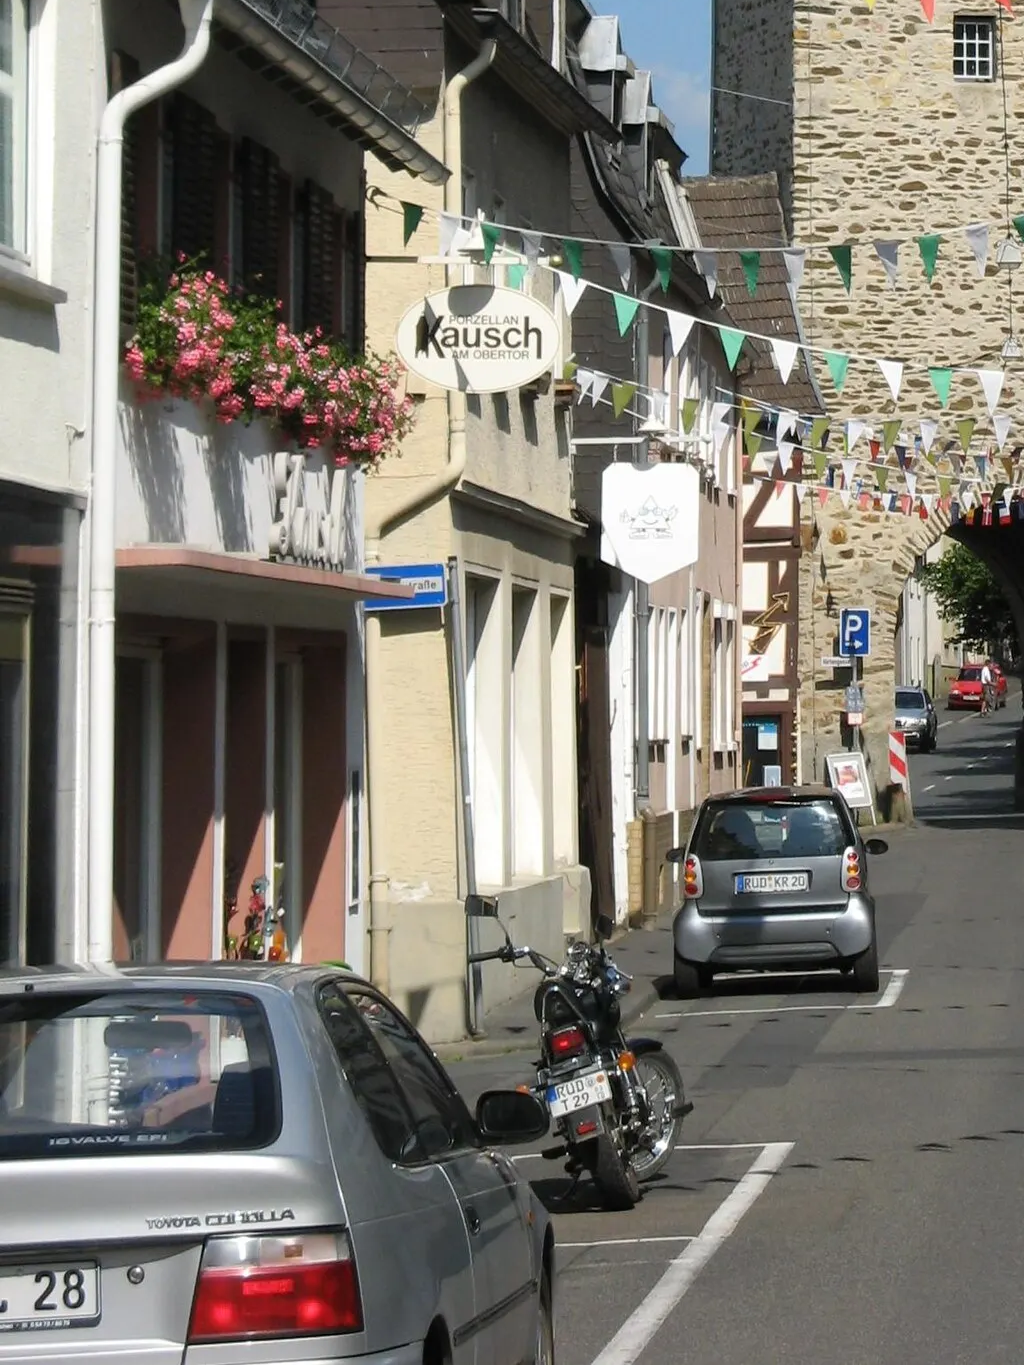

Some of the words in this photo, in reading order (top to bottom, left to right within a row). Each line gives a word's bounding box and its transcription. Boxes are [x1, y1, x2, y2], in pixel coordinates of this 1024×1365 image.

[449, 314, 519, 325] PORZELLAN
[415, 315, 542, 359] Kausch
[451, 349, 469, 359] AM
[473, 349, 530, 360] OBERTOR
[744, 877, 767, 890] RUD
[774, 876, 789, 888] KR
[791, 875, 805, 887] 20
[556, 1079, 585, 1099] RUD
[561, 1098, 569, 1111] T
[572, 1092, 590, 1109] 29
[145, 1215, 201, 1229] TOYOTA
[34, 1268, 86, 1312] 28
